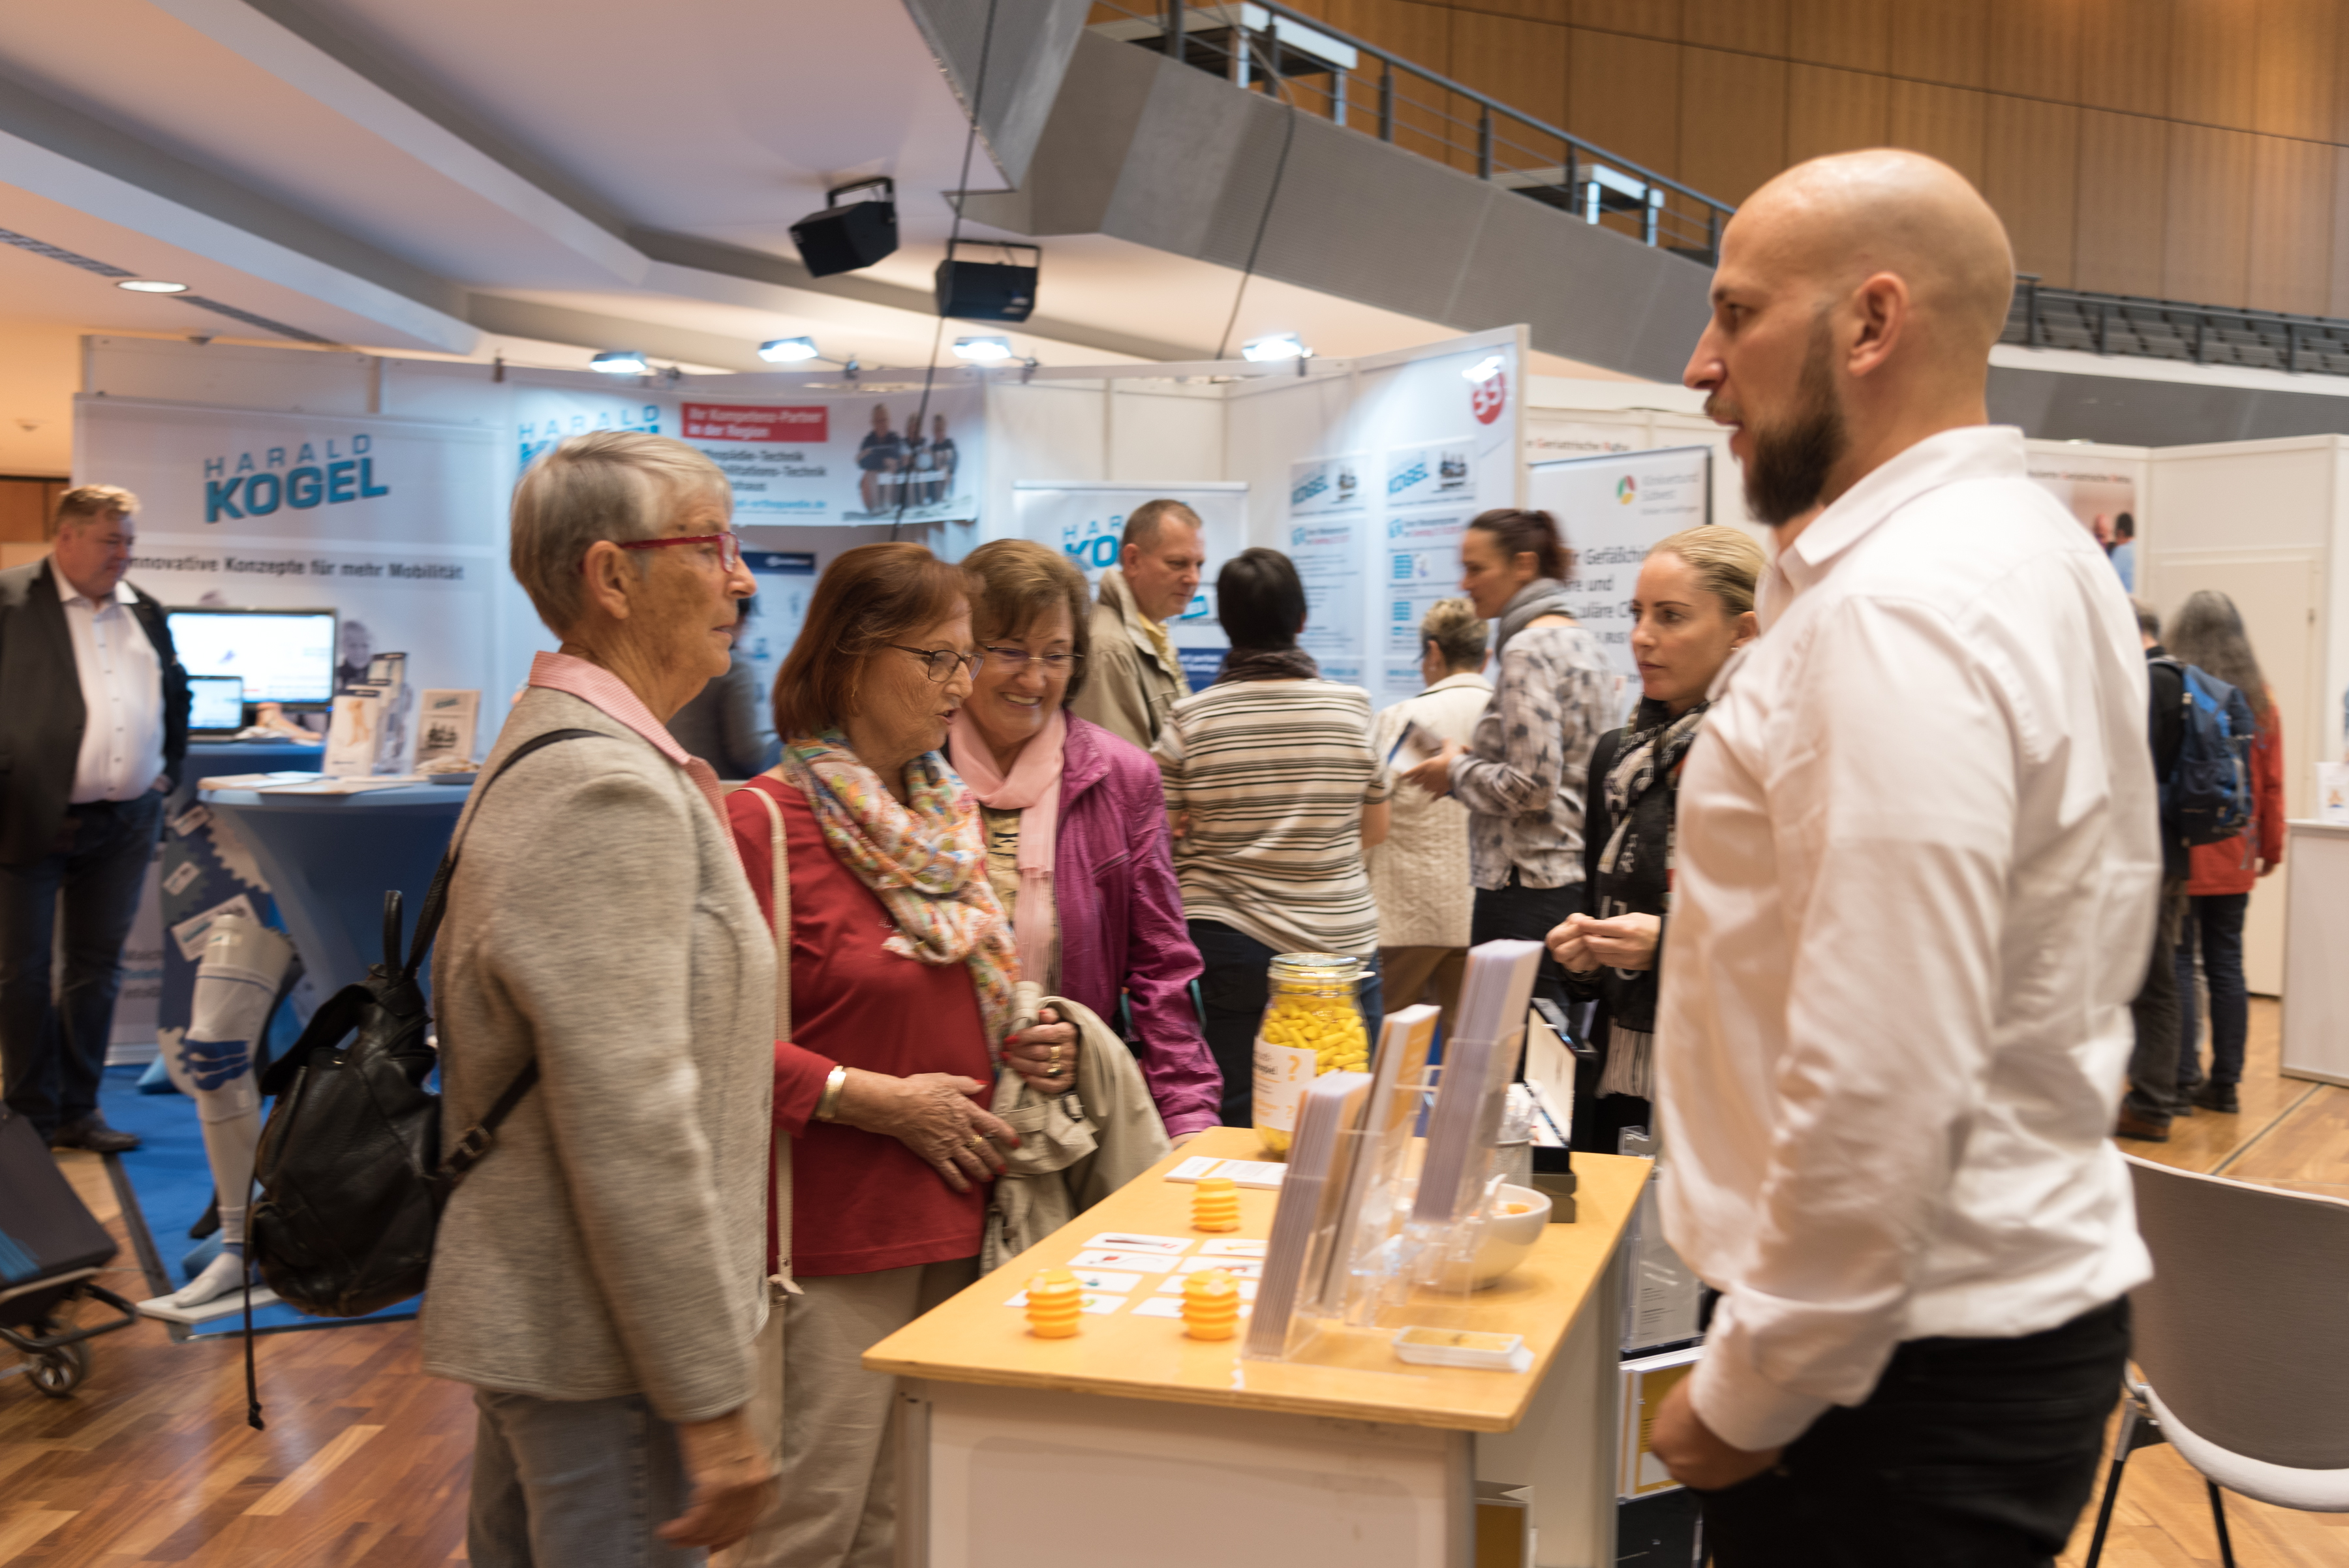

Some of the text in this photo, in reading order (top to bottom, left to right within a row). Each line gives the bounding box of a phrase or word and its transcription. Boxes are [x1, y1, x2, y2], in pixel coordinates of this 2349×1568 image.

[518, 404, 659, 440] HARALD
[205, 434, 371, 478] HARALD
[206, 457, 390, 524] KOGEL
[1062, 514, 1124, 542] HAR
[130, 557, 464, 580] nnovative Konzepte für mehr Mobilität
